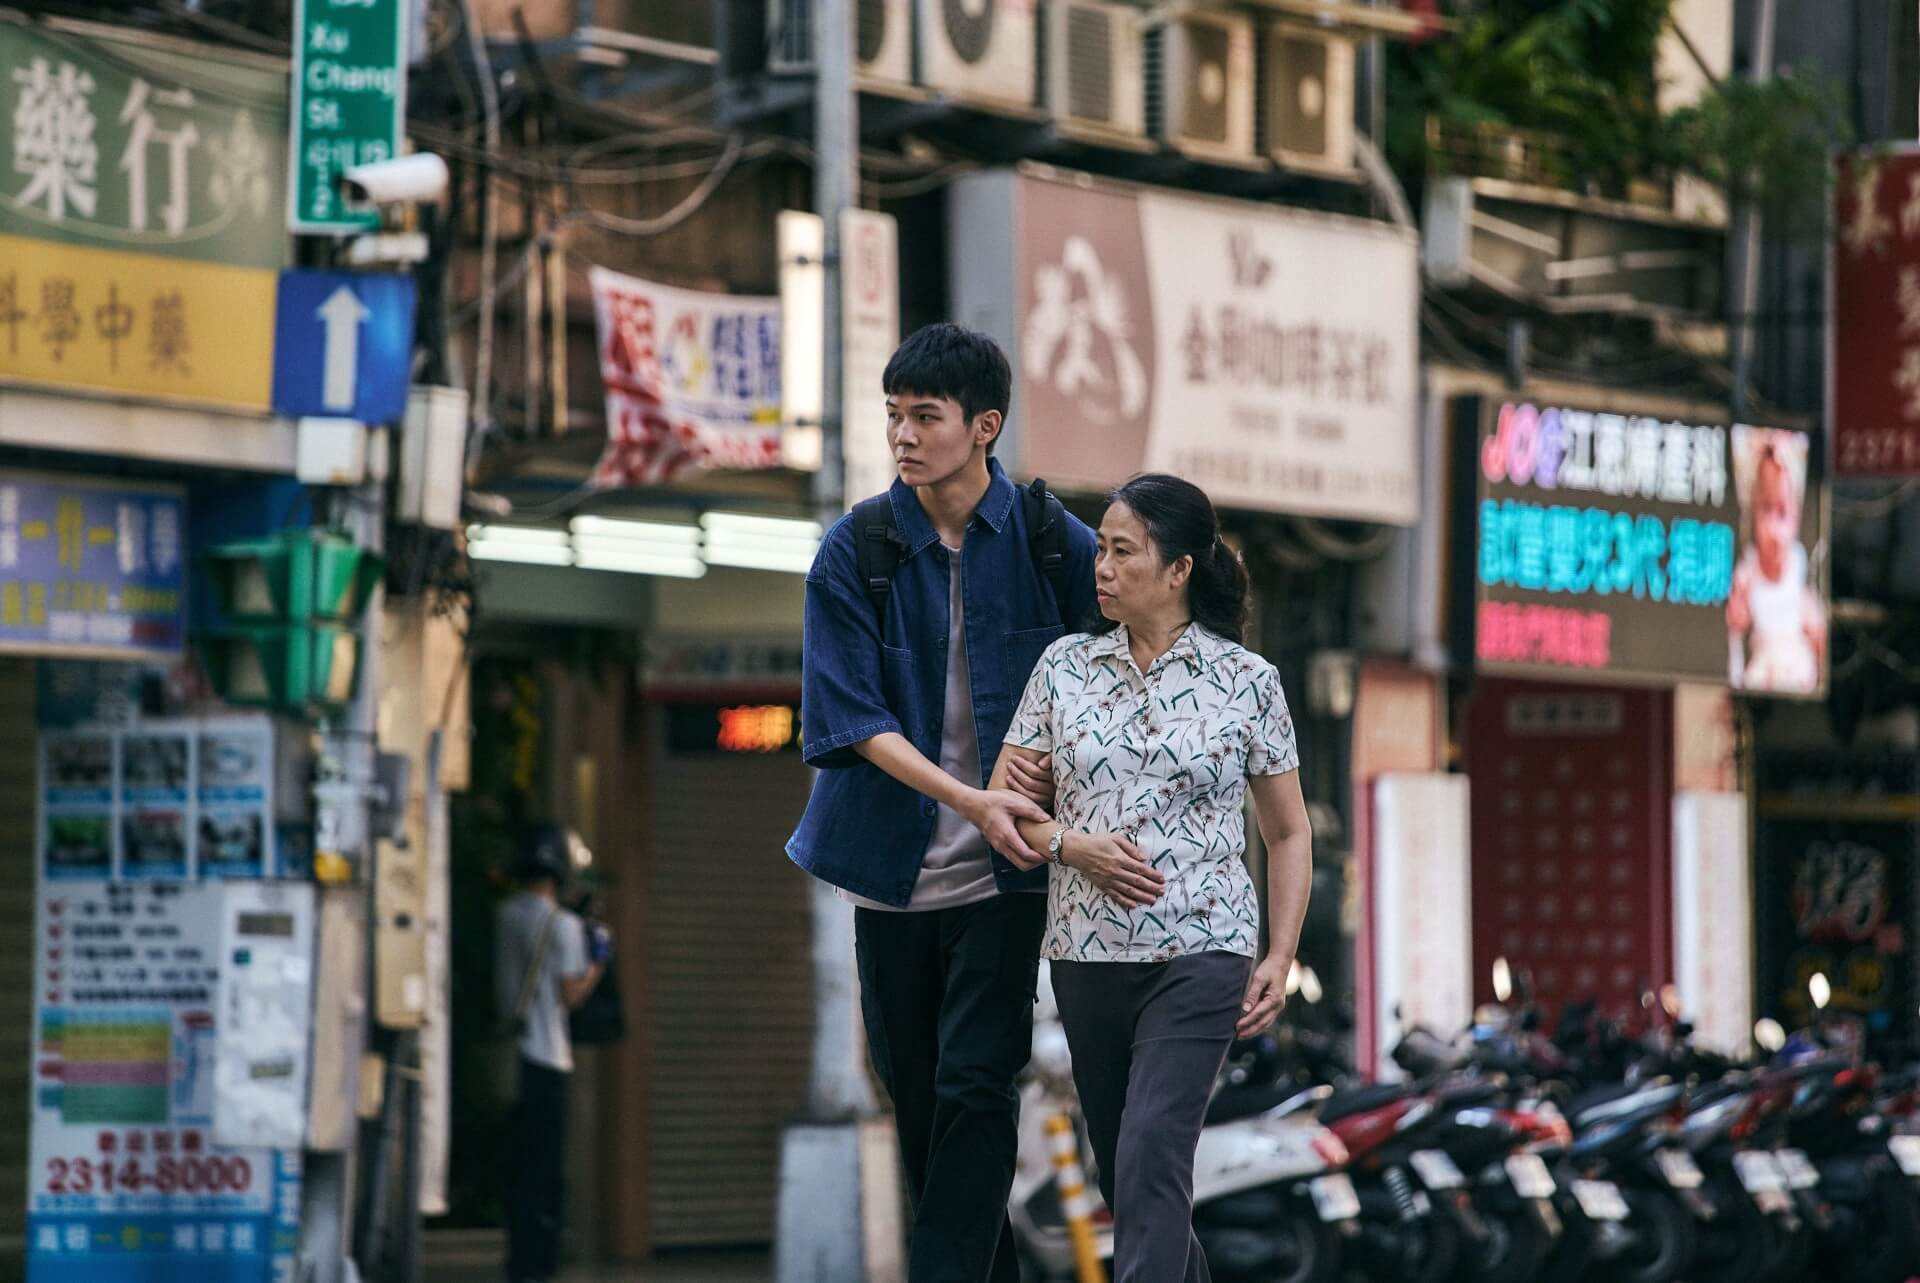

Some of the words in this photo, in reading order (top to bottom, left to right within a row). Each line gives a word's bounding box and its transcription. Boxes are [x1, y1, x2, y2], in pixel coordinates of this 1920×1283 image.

[306, 60, 397, 99] Chang
[12, 56, 200, 237] 藥行
[47, 1156, 252, 1194] 2314-8000
